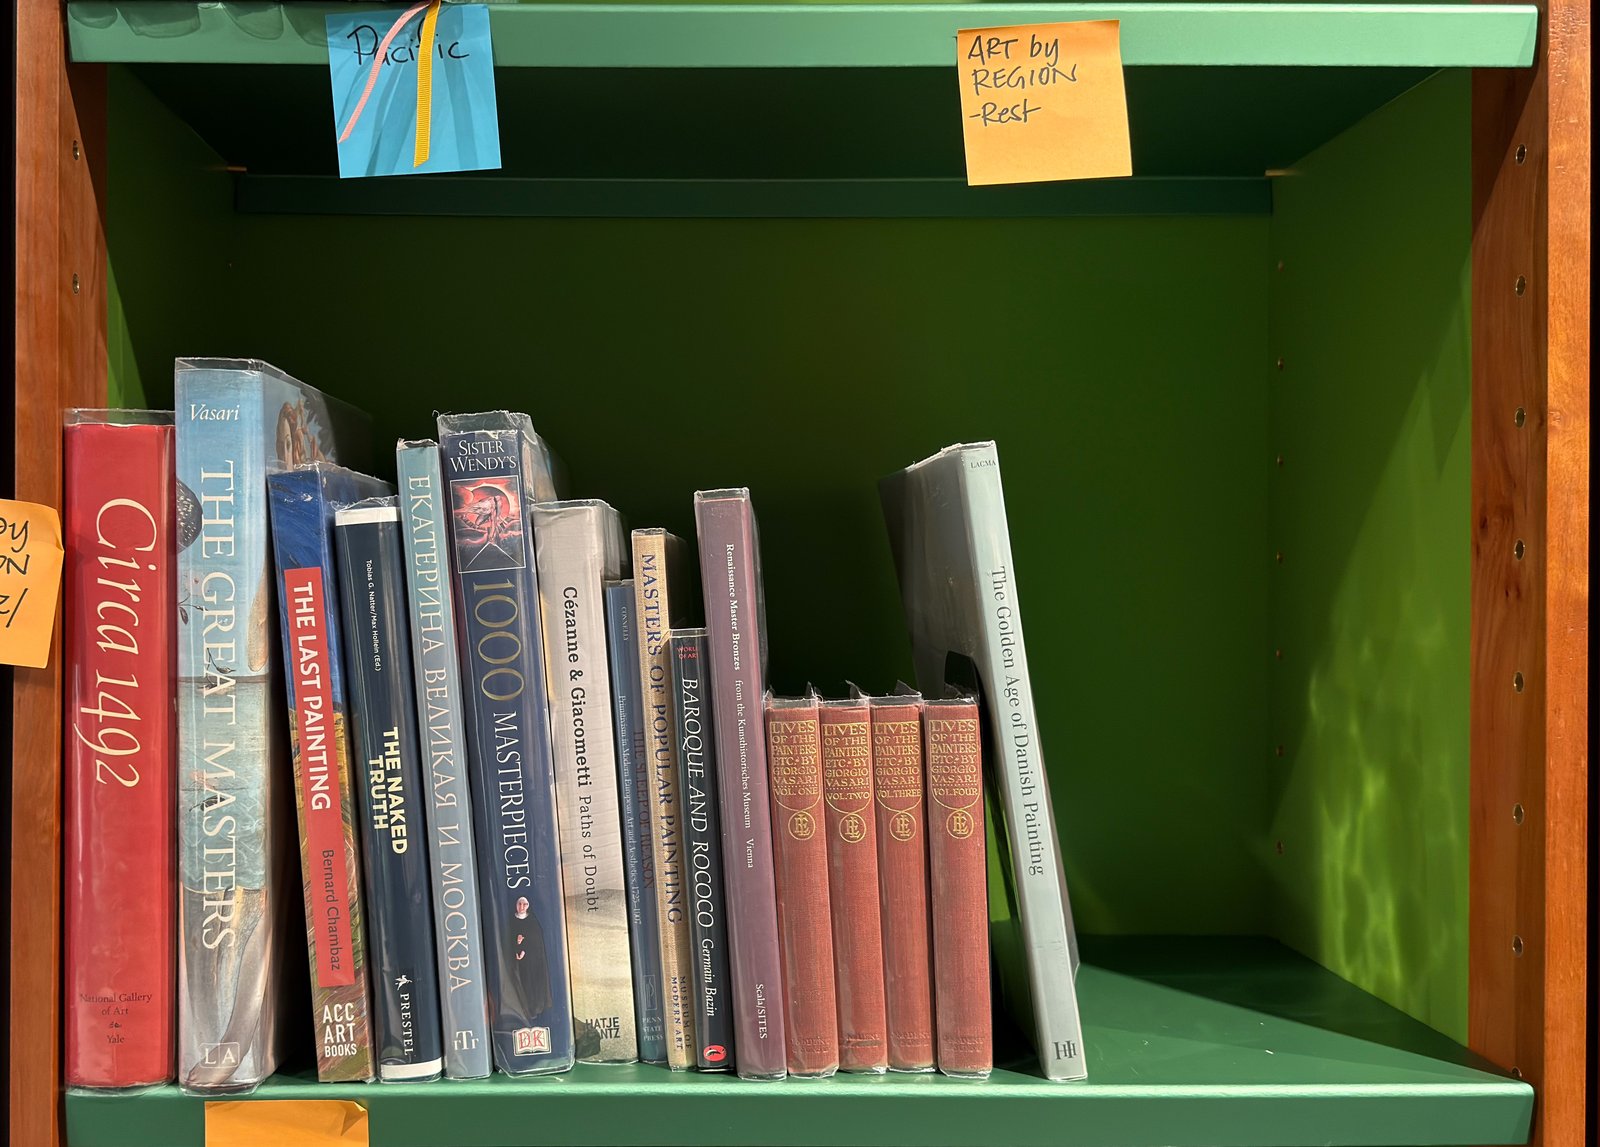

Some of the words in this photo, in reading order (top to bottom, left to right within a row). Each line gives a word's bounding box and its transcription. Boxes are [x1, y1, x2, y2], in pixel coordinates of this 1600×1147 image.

[968, 35, 1019, 65] ART
[1030, 34, 1059, 67] by
[972, 64, 1077, 96] REGION
[189, 403, 240, 421] Vasari
[458, 440, 504, 456] SISTER
[450, 455, 517, 473] WENDY'S
[970, 460, 997, 469] LACMA
[200, 459, 236, 558] THE
[95, 498, 158, 656] Circa
[408, 474, 445, 655] ЕКАТЕРИНА
[726, 543, 736, 598] Renaissance
[367, 582, 375, 590] G.
[991, 566, 1007, 601] The
[293, 581, 316, 629] THE
[368, 591, 378, 629] Natter/Max
[641, 554, 662, 657] MASTERS
[730, 600, 738, 631] Master
[472, 578, 525, 701] 1000
[563, 586, 579, 663] Cézanne
[996, 606, 1015, 668] Golden
[200, 571, 237, 725] GREAT
[372, 631, 380, 654] Hollein
[732, 633, 741, 671] Bronzes
[297, 635, 321, 690] LAST
[569, 668, 584, 681] &
[649, 664, 665, 695] OF
[735, 680, 744, 702] from
[1003, 675, 1021, 707] Age
[736, 703, 745, 717] the
[1010, 712, 1027, 730] of
[73, 672, 143, 788] 1492
[424, 667, 457, 809] ВЕЛИКАЯ
[571, 687, 592, 788] Giacometti
[682, 678, 705, 778] BAROQUE
[771, 722, 816, 734] LIVES
[772, 735, 789, 744] OF
[790, 734, 816, 743] THE
[823, 724, 868, 736] LIVES
[824, 737, 840, 746] OF
[844, 736, 867, 745] THE
[874, 722, 919, 735] LIVES
[874, 736, 891, 745] OF
[893, 735, 918, 744] THE
[931, 721, 976, 732] LIVES
[931, 733, 948, 742] OF
[949, 733, 976, 742] THE
[303, 697, 331, 811] PAINTING
[383, 726, 402, 771] THE
[652, 704, 673, 806] POPULAR
[738, 719, 749, 790] Kunsthistorisches
[772, 744, 817, 756] PAINTERS
[801, 756, 817, 765] BY
[824, 747, 869, 758] PAINTERS
[853, 758, 868, 767] BY
[875, 745, 920, 756] PAINTERS
[904, 756, 920, 766] BY
[931, 743, 977, 754] PAINTERS
[960, 754, 977, 763] BY
[773, 766, 817, 775] GIORGIO
[773, 775, 818, 785] VASARI
[825, 767, 869, 777] GIORGIO
[876, 766, 920, 776] GIORGIO
[932, 765, 977, 774] GIORGIO
[932, 775, 977, 783] VASARI
[1013, 734, 1036, 796] Danish
[368, 755, 389, 829] TRUTH
[798, 787, 819, 796] ONE
[826, 777, 870, 787] VASARI
[876, 776, 921, 786] VASARI
[387, 776, 408, 854] NAKED
[493, 711, 532, 890] MASTERPIECES
[688, 785, 708, 832] AND
[742, 791, 752, 828] Museum
[579, 795, 594, 839] Paths
[201, 739, 236, 950] MASTERS
[582, 844, 597, 859] of
[745, 838, 754, 869] Vienna
[1023, 802, 1044, 875] Painting
[322, 849, 339, 903] Bernard
[660, 815, 682, 924] PAINTING
[692, 841, 714, 928] ROCOCO
[584, 866, 599, 912] Doubt
[326, 906, 343, 971] Chambaz
[440, 862, 472, 993] МОСКВА
[701, 938, 716, 983] Germain
[80, 993, 117, 1003] National
[118, 992, 153, 1003] Gallery
[101, 1006, 112, 1015] of
[113, 1006, 129, 1015] Art
[323, 1003, 355, 1023] ACC
[671, 976, 682, 1024] MODERN
[680, 976, 691, 1029] MUSEUM
[705, 986, 718, 1017] Bazin
[755, 983, 768, 1039] Scala/SITES
[324, 1022, 356, 1044] ART
[400, 992, 414, 1056] PRESTEL
[585, 1016, 620, 1029] HATJE
[597, 1028, 621, 1040] NTZ
[107, 1034, 125, 1044] Yale
[324, 1042, 357, 1058] BOOKS
[519, 1029, 545, 1050] DK
[675, 1029, 683, 1050] ART
